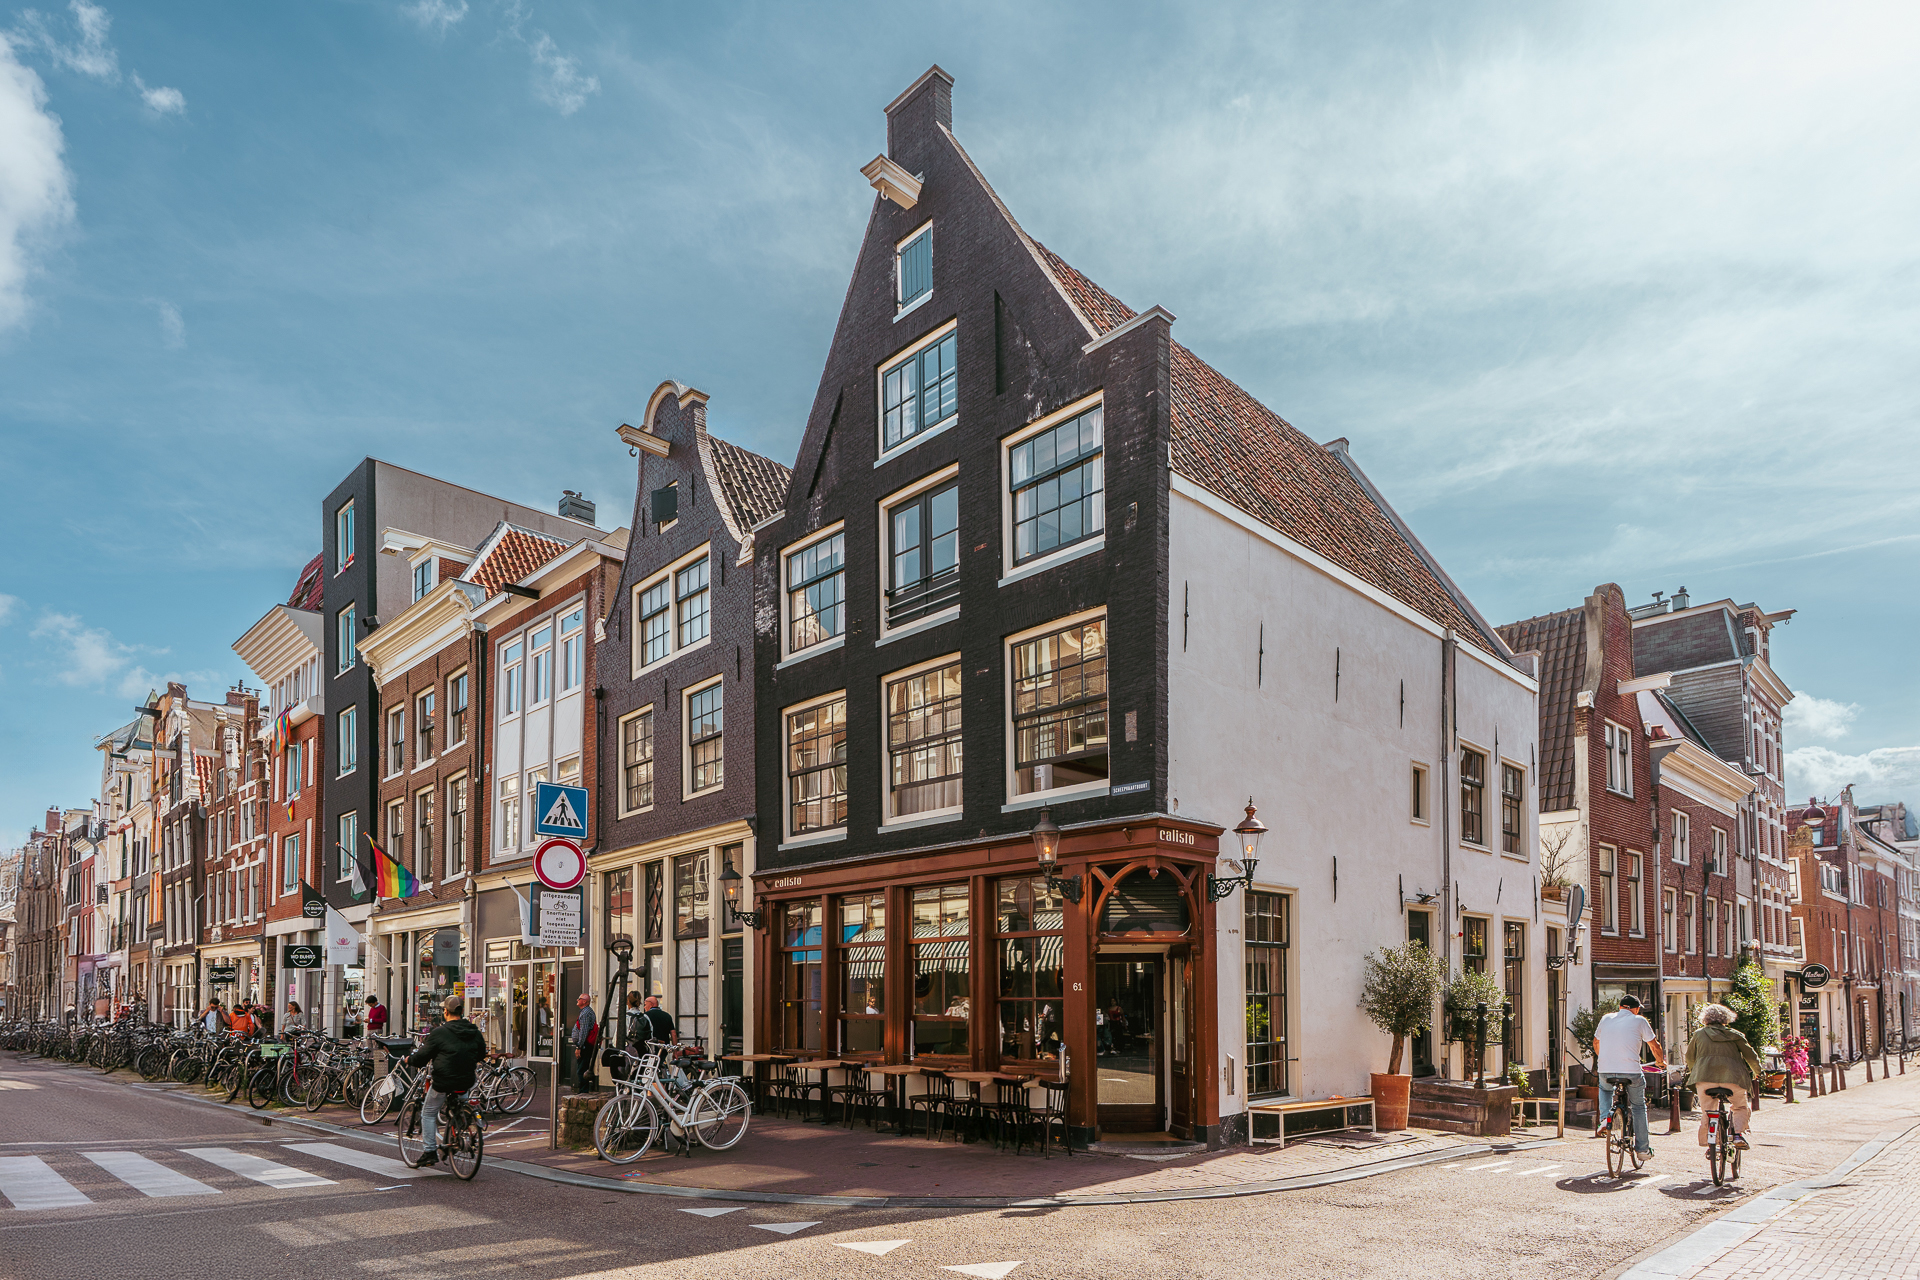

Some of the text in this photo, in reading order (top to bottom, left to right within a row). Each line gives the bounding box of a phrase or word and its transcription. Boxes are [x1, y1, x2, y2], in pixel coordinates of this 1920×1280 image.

[1160, 829, 1194, 845] calisto
[774, 876, 802, 888] calisto
[1072, 982, 1083, 991] 61
